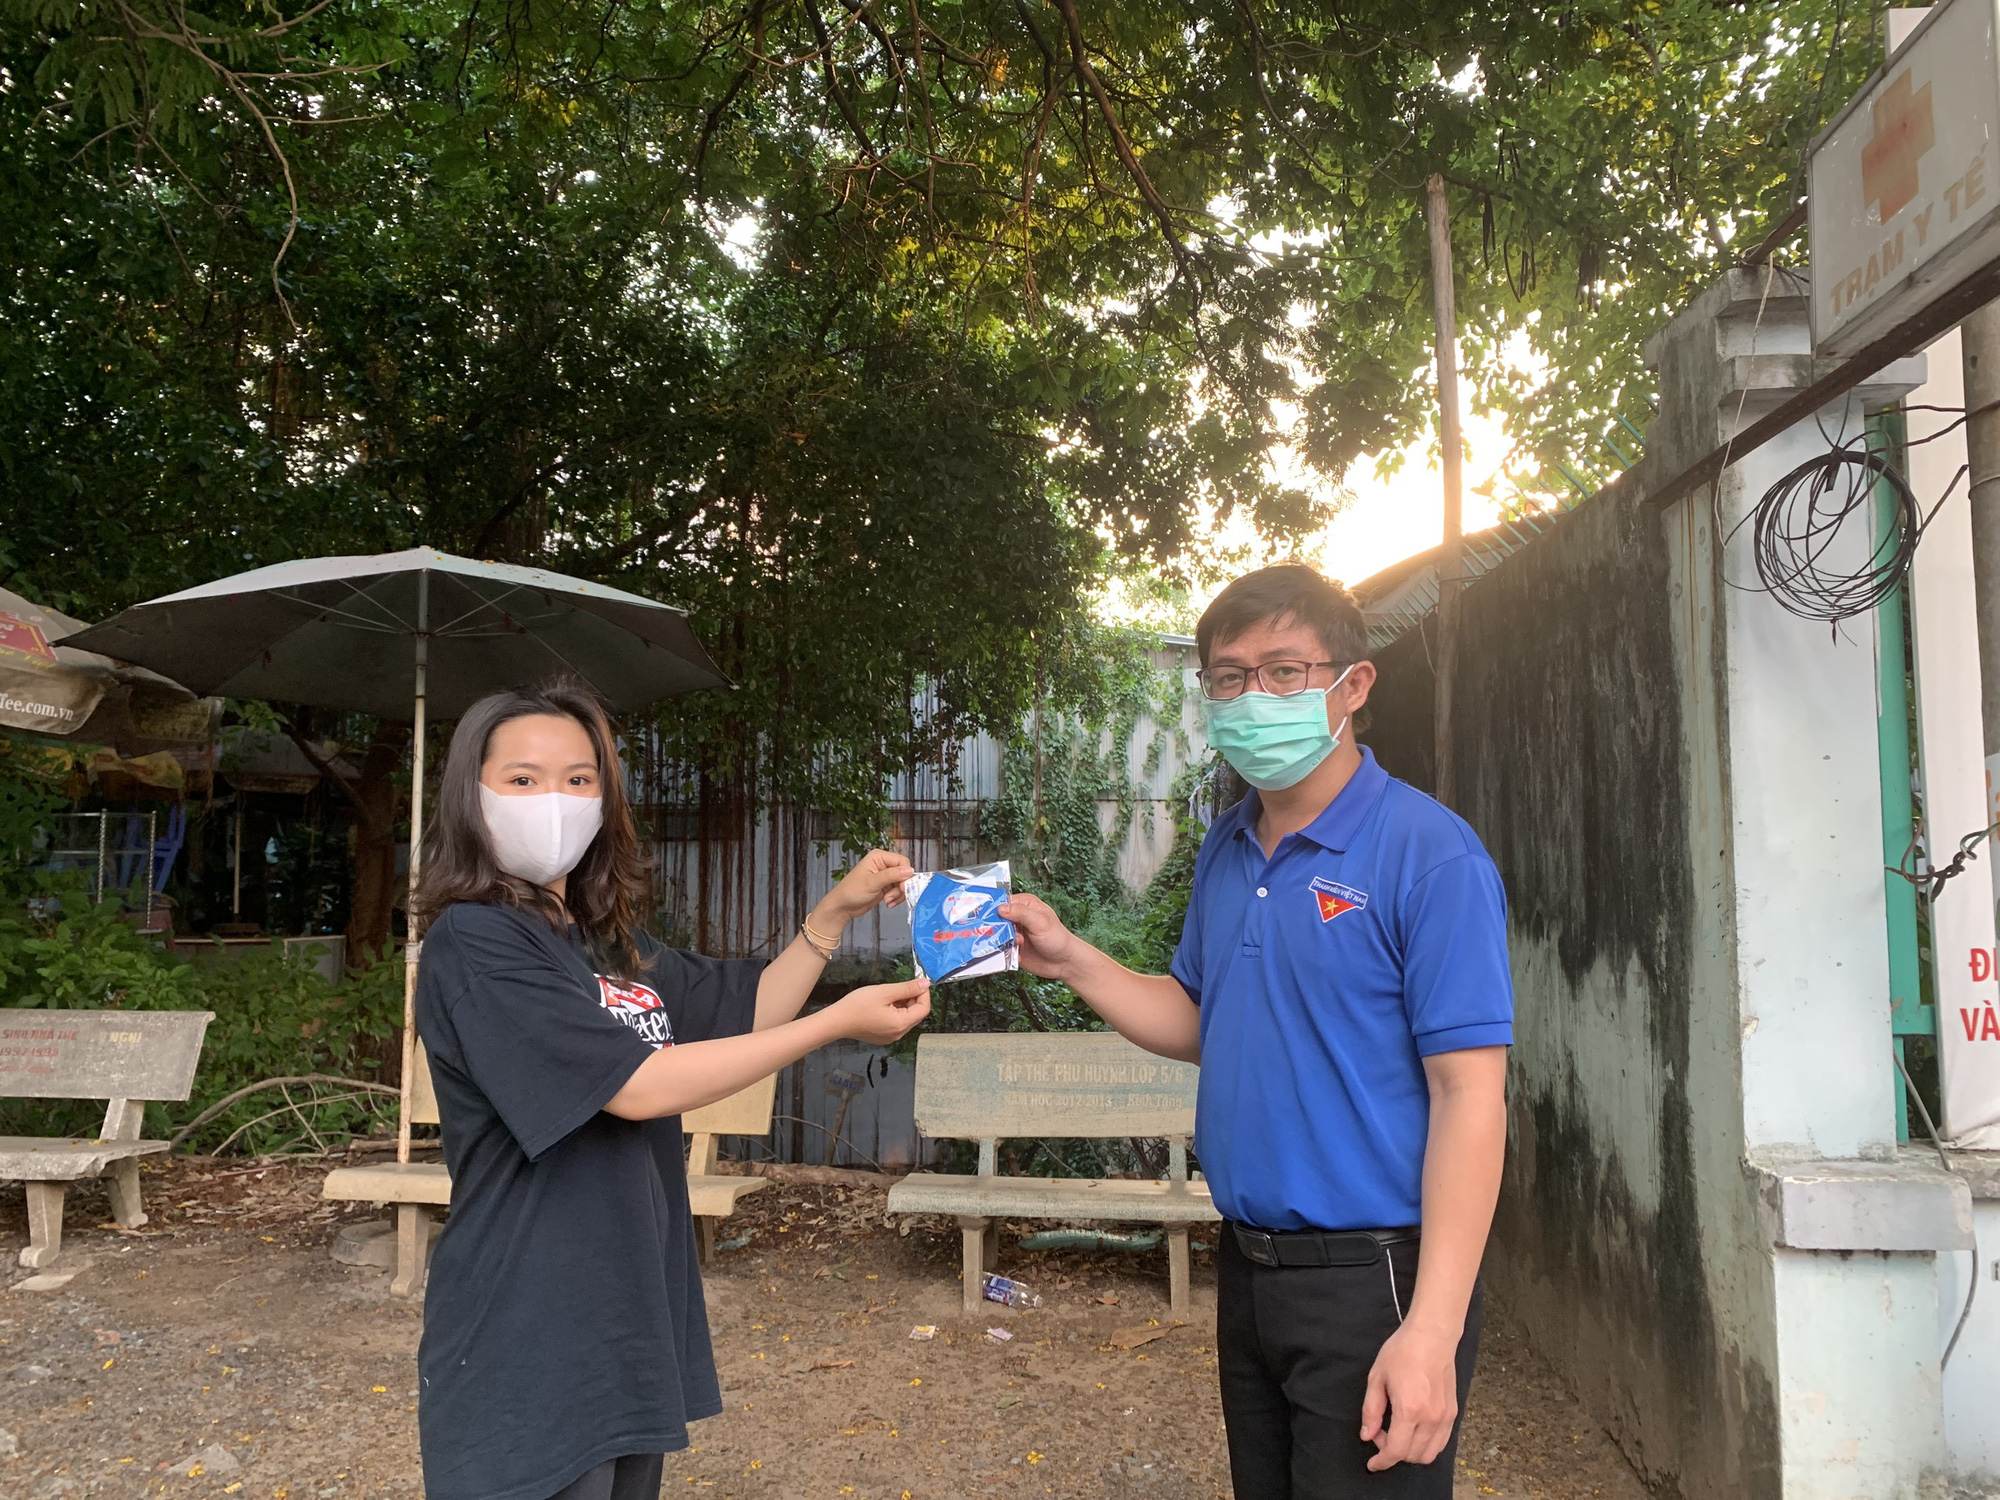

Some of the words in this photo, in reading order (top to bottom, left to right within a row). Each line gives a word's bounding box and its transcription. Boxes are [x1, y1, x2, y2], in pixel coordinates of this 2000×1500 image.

[1830, 230, 1904, 316] TRẠM
[1913, 202, 1935, 247] Y
[1944, 142, 1987, 224] TẾ
[0, 692, 74, 722] fee.com.vn
[1960, 1000, 2000, 1041] VÀ
